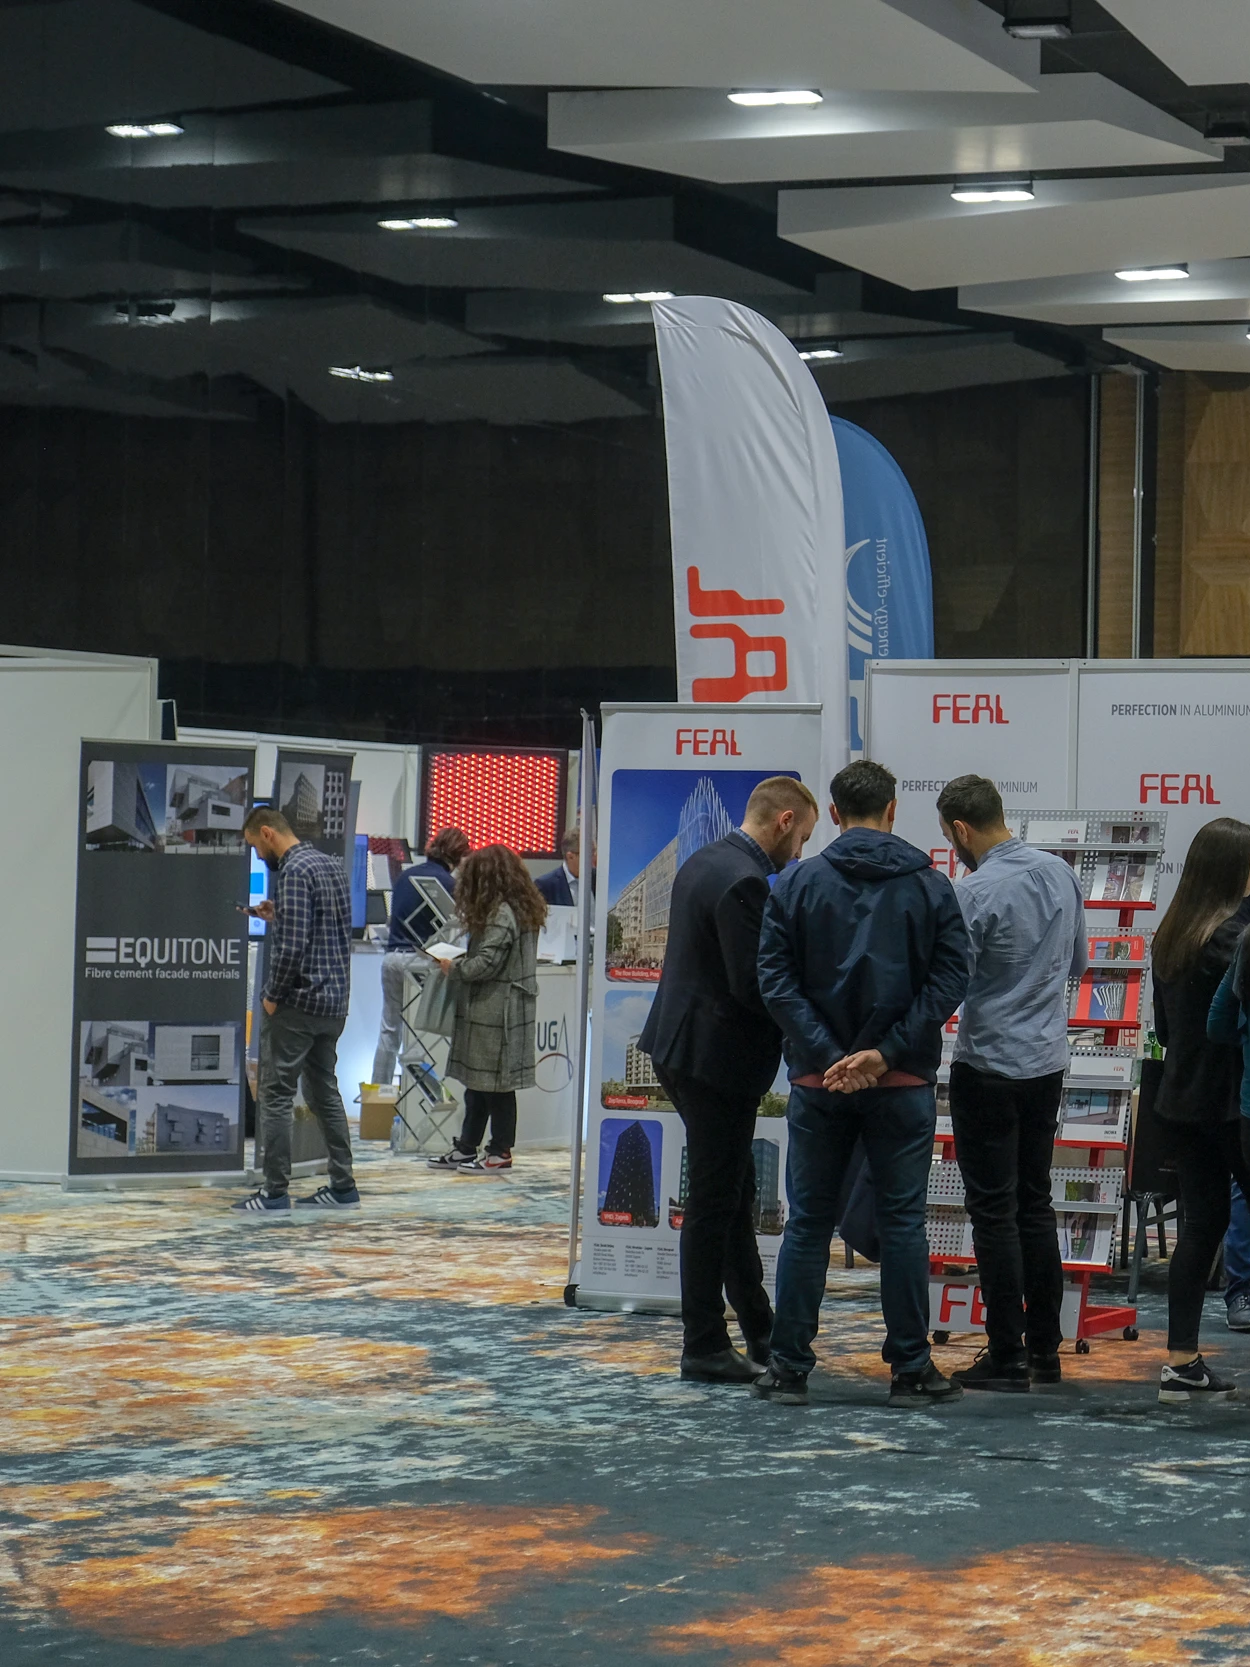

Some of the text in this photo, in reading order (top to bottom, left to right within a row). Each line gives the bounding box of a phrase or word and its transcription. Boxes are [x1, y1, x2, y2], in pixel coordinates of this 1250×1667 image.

[932, 694, 1010, 724] FEAL
[1111, 704, 1177, 716] PERFECTION
[1180, 704, 1191, 716] IN
[675, 728, 743, 756] FEAL
[1139, 773, 1221, 805] FEAL
[118, 937, 241, 968] EQUITONE
[84, 967, 240, 980] Fibre cement facade materials
[938, 1284, 987, 1326] FE
